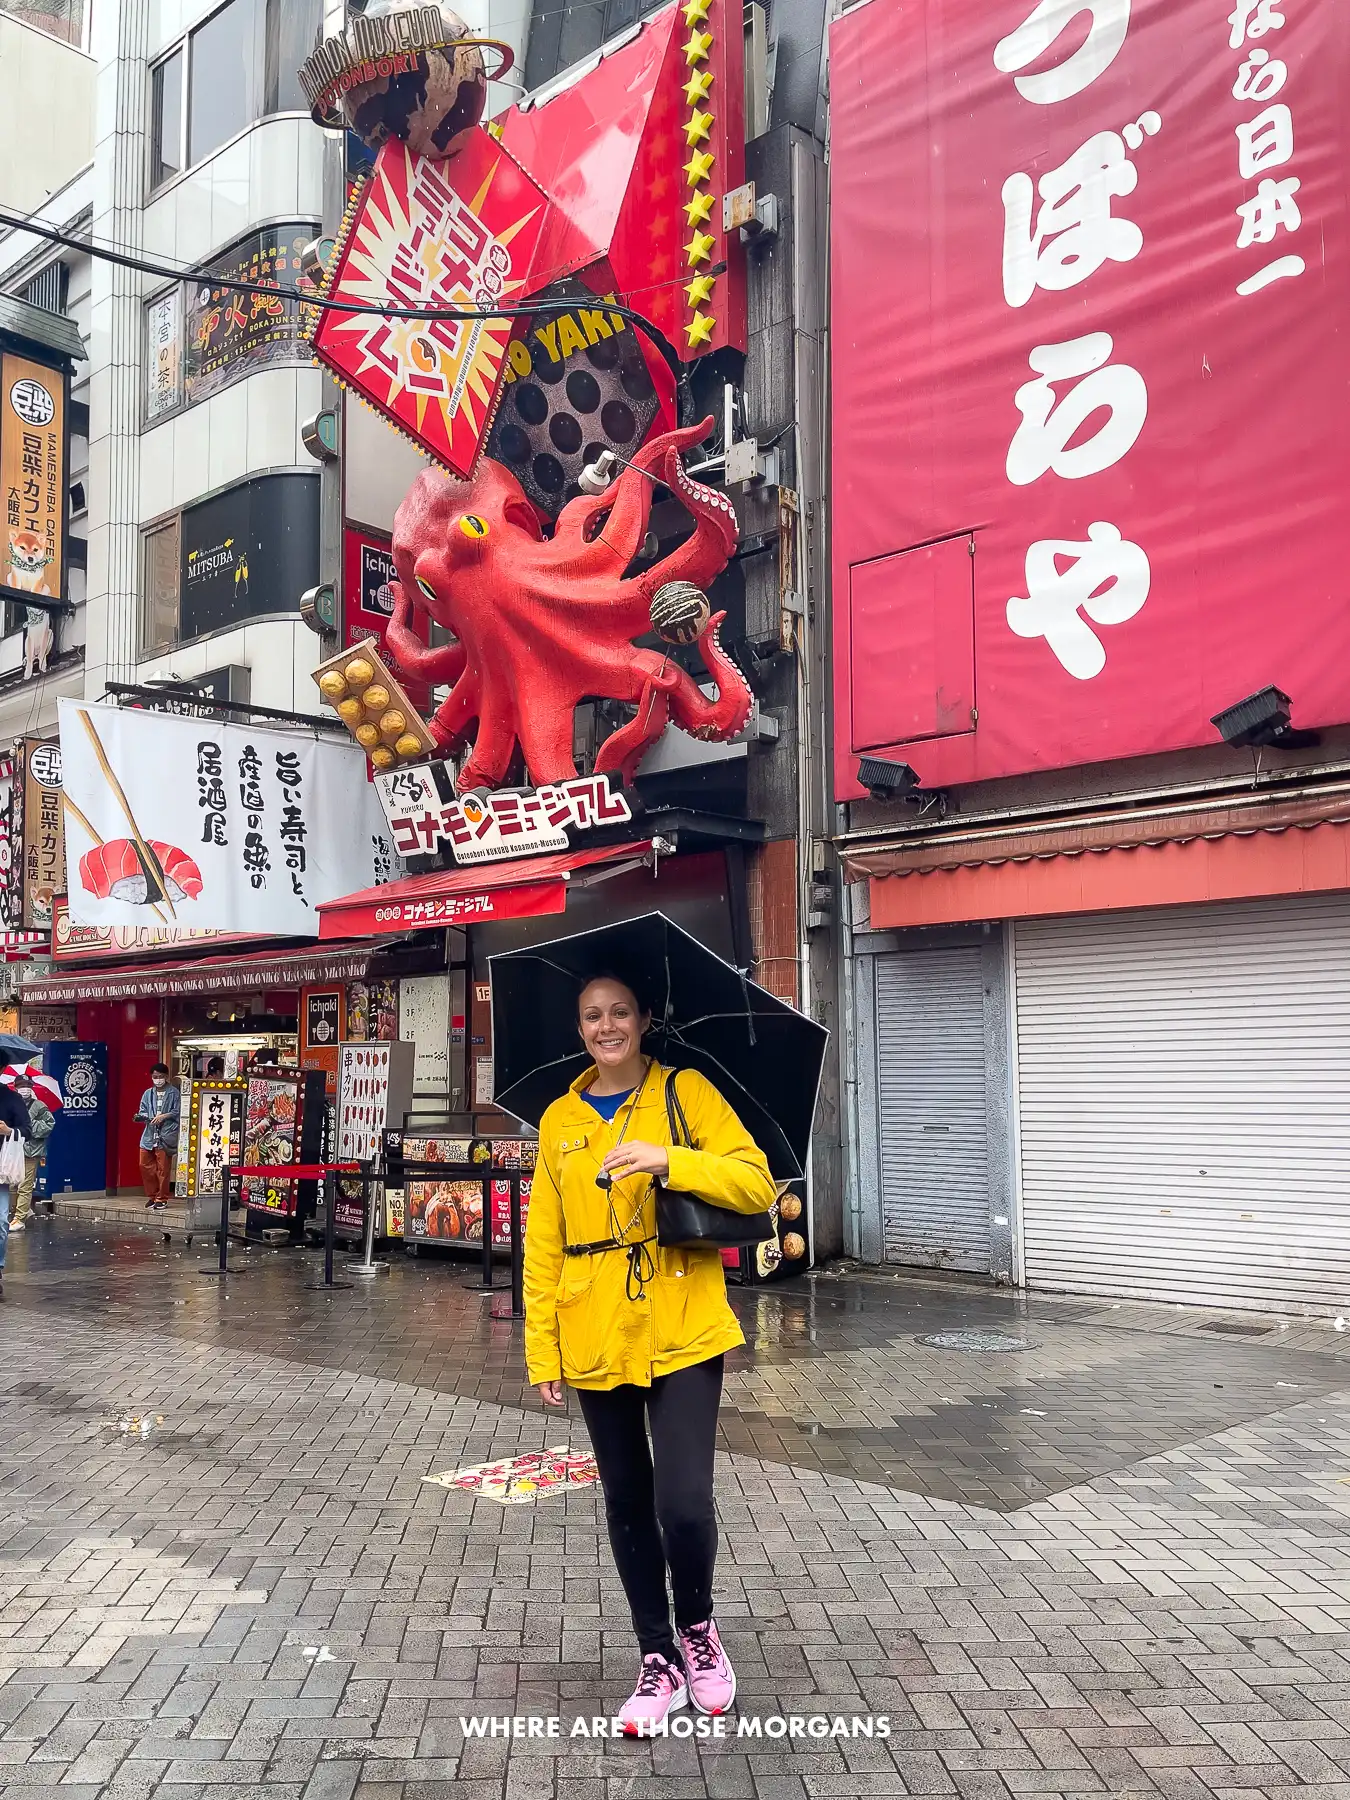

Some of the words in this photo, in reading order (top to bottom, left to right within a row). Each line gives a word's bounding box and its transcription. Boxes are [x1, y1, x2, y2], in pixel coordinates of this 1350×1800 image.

[352, 5, 445, 60] MUSEUM
[318, 52, 420, 117] DOTONBORI
[535, 293, 626, 364] YAKI
[22, 431, 43, 533] 豆柴カフェ
[46, 433, 57, 514] MAMESHIBA
[7, 486, 21, 527] 大阪店
[45, 520, 56, 558] CAFE
[187, 549, 234, 579] MITSUBA
[197, 741, 229, 846] 居酒屋
[41, 791, 58, 883] 豆柴カフェ
[238, 745, 271, 890] 産直の魚の
[390, 781, 626, 852] コナモンミュージアム
[27, 844, 39, 880] 大阪店
[403, 895, 494, 920] コナモンミュージアム
[406, 1008, 415, 1017] 3F
[478, 987, 490, 999] 1F
[406, 1031, 415, 1039] 2F
[67, 1061, 95, 1072] COFFEE
[343, 1049, 353, 1100] 串カツ
[63, 1096, 98, 1109] BOSS
[266, 1188, 282, 1208] 2F
